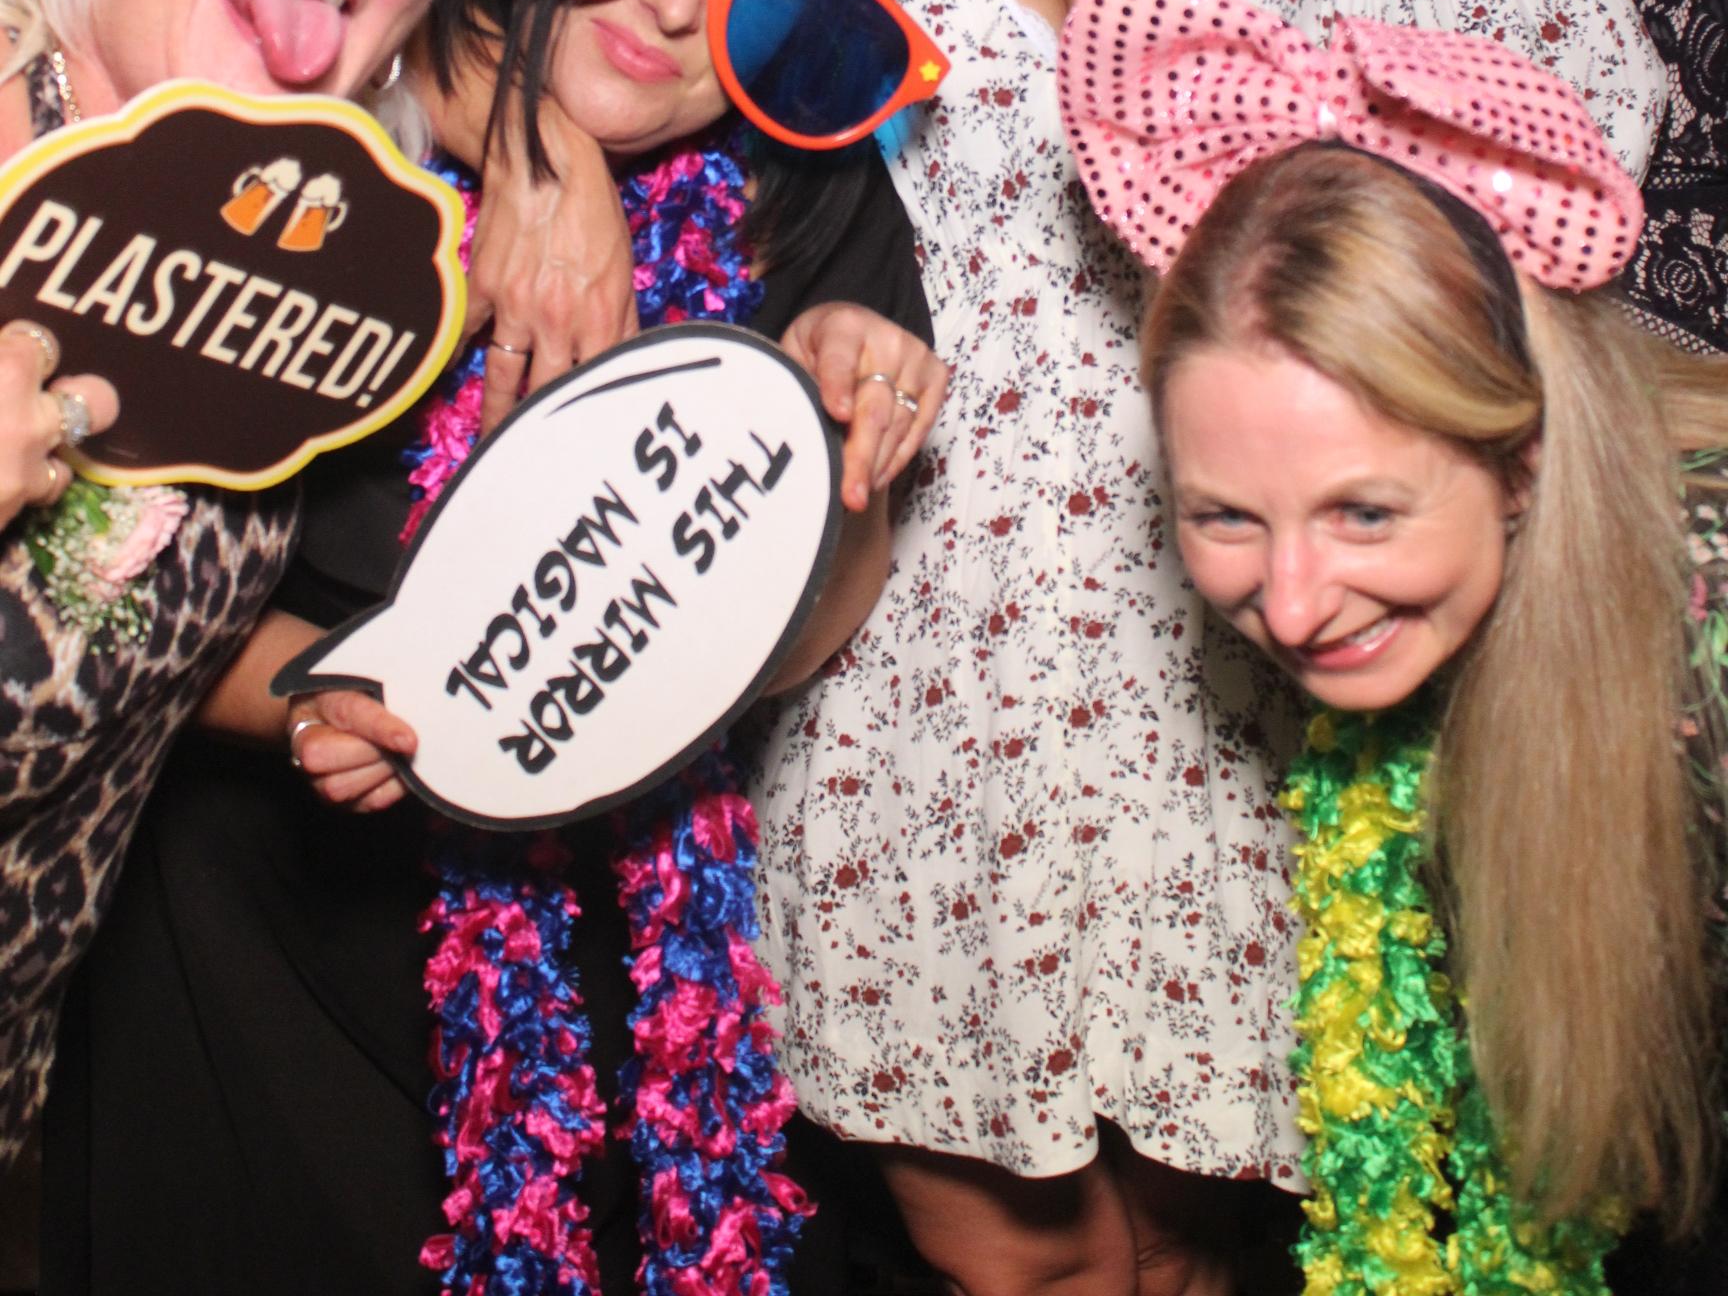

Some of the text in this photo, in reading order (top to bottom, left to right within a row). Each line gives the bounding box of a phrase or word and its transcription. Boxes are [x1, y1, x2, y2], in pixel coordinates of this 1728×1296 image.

[0, 200, 416, 408] PLASTERED!
[444, 401, 703, 711] IS MAGICAL
[498, 431, 794, 775] THIS MIRROR
